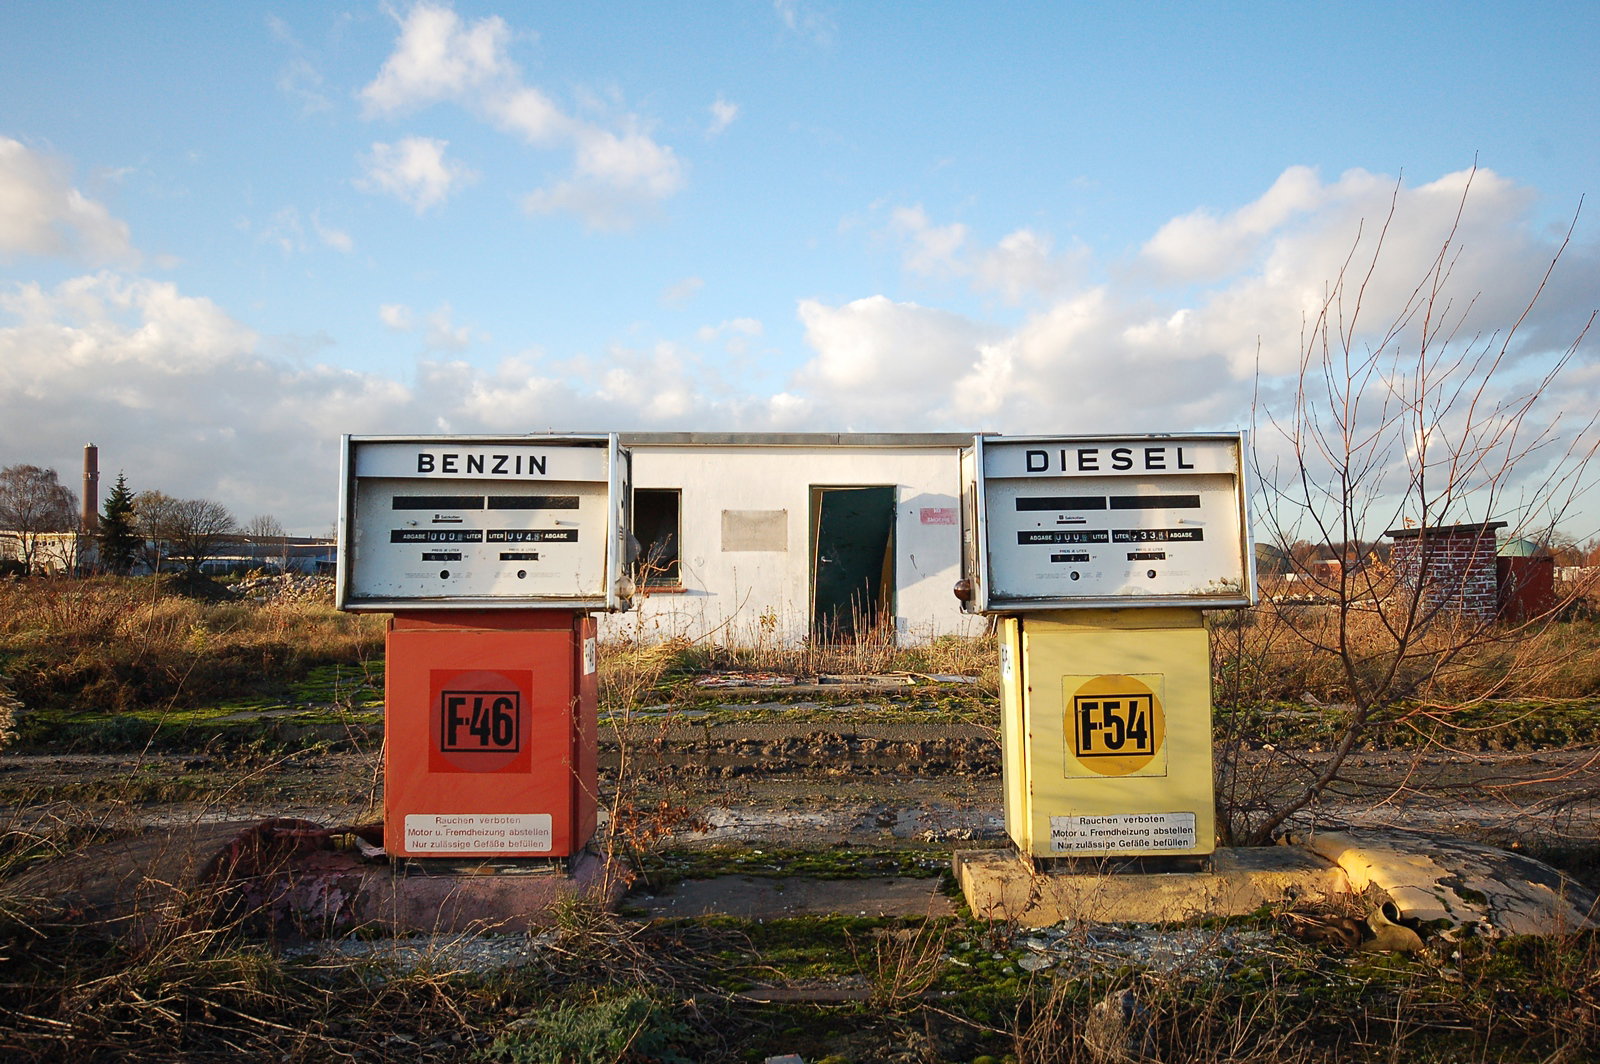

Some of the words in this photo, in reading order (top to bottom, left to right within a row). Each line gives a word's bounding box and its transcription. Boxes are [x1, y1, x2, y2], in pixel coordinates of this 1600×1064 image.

[417, 453, 547, 475] BENZIN
[1026, 447, 1194, 473] DIESEL
[435, 816, 474, 824] Rauchen
[479, 816, 521, 824] verboten
[1079, 817, 1118, 825] Rauchen
[1123, 816, 1165, 824] verboten
[445, 828, 505, 837] Fremdheizung
[509, 828, 549, 836] abstellen
[1052, 829, 1077, 838] Motor
[1090, 828, 1150, 838] Fremdheizung
[1153, 826, 1193, 835] abstellen
[412, 840, 427, 848] Nur
[430, 840, 471, 849] zulässige
[473, 839, 505, 848] Gefäße
[508, 839, 544, 848] befüllen
[1057, 841, 1072, 849] Nur
[1075, 840, 1116, 850] zulässige
[1118, 839, 1150, 847] Gefäße
[1153, 838, 1188, 847] befüllen
